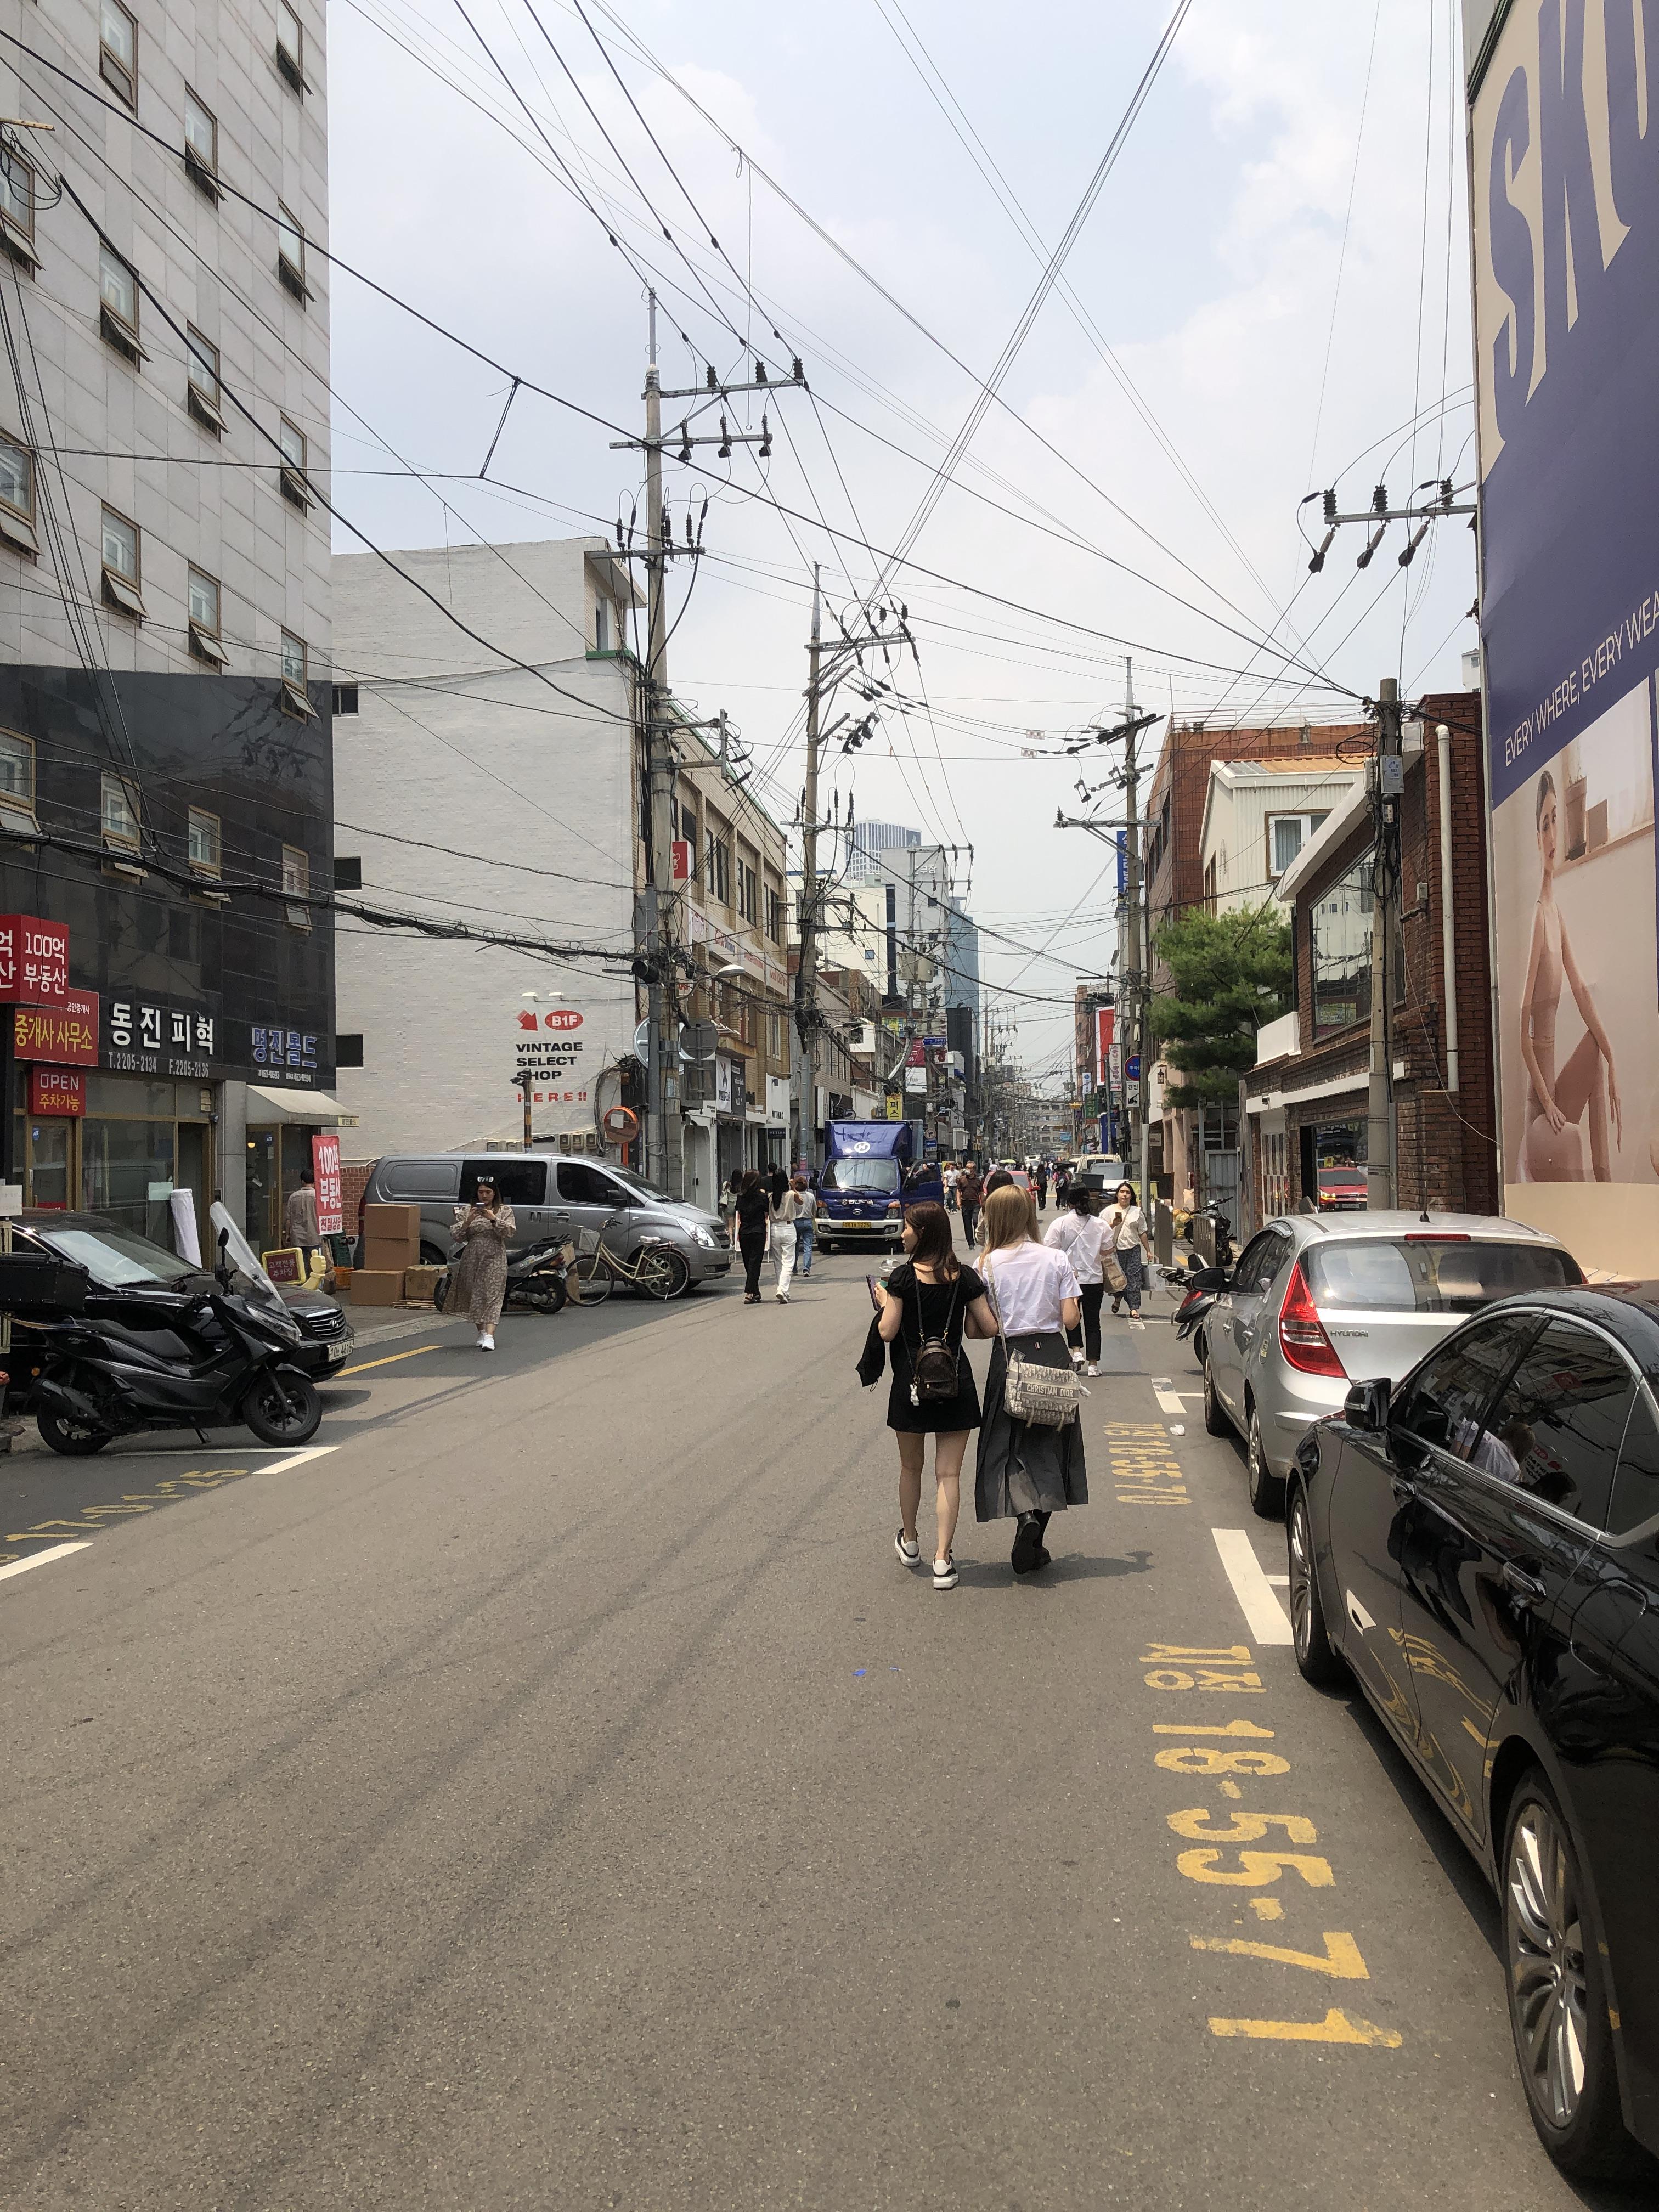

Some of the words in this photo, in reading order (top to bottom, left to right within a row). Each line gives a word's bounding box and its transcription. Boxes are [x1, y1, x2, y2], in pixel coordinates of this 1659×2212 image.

[1582, 624, 1623, 692] EVERY
[25, 932, 65, 965] 100억
[24, 962, 66, 995] 부동산
[67, 1002, 90, 1014] 공인중개사
[552, 1015, 578, 1026] B1F
[15, 1015, 54, 1050] 중개사
[57, 1020, 93, 1053] 사무소
[252, 1027, 317, 1068] 명진몰드
[516, 1042, 583, 1053] VINTAGE
[516, 1056, 577, 1066] SELECT
[40, 1074, 78, 1090] OPEN
[40, 1093, 80, 1111] 주차가능
[319, 1144, 339, 1176] 100억
[320, 1177, 341, 1209] 부동산
[268, 1259, 295, 1268] 고객전용
[1026, 1384, 1058, 1396] CHRISTIAN
[1060, 1388, 1074, 1397] DIOR
[1103, 1421, 1169, 1437] 지정
[1139, 1643, 1267, 1694] 지정
[1152, 1719, 1403, 2049] 18-55-71
